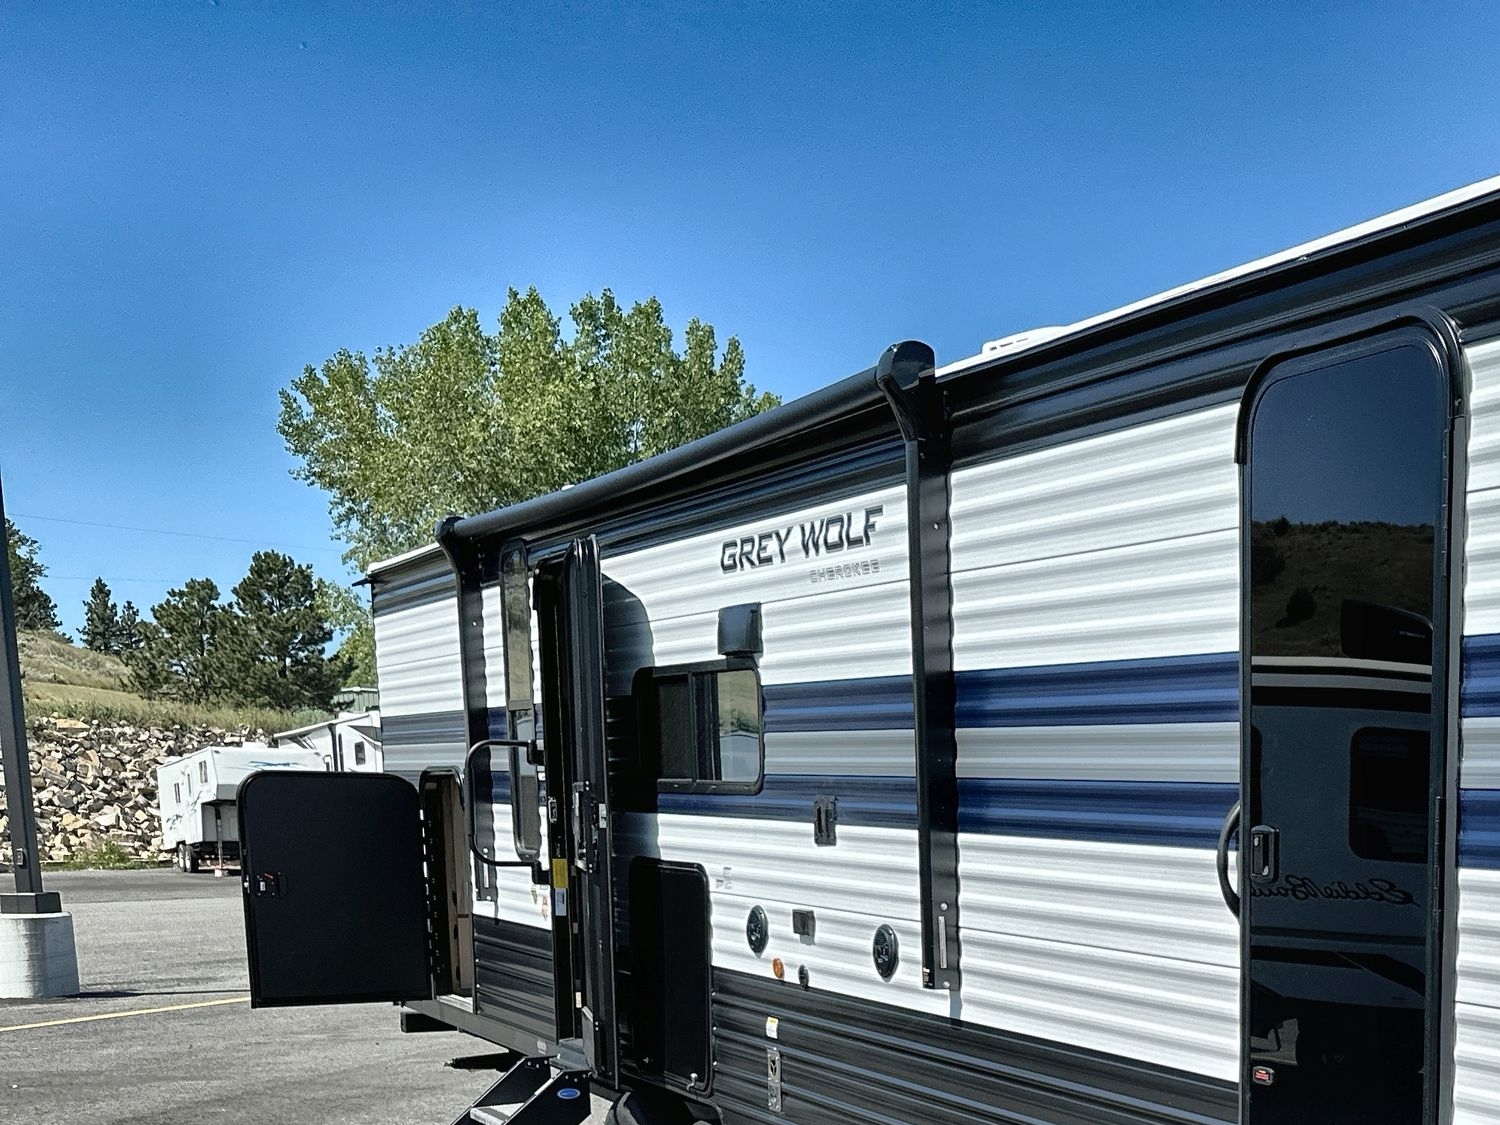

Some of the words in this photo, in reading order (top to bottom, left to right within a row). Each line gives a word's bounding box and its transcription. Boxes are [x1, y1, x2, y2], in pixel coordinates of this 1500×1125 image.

[720, 526, 794, 575] GREY
[799, 504, 884, 559] WOLF
[809, 559, 881, 584] CHEROKEE
